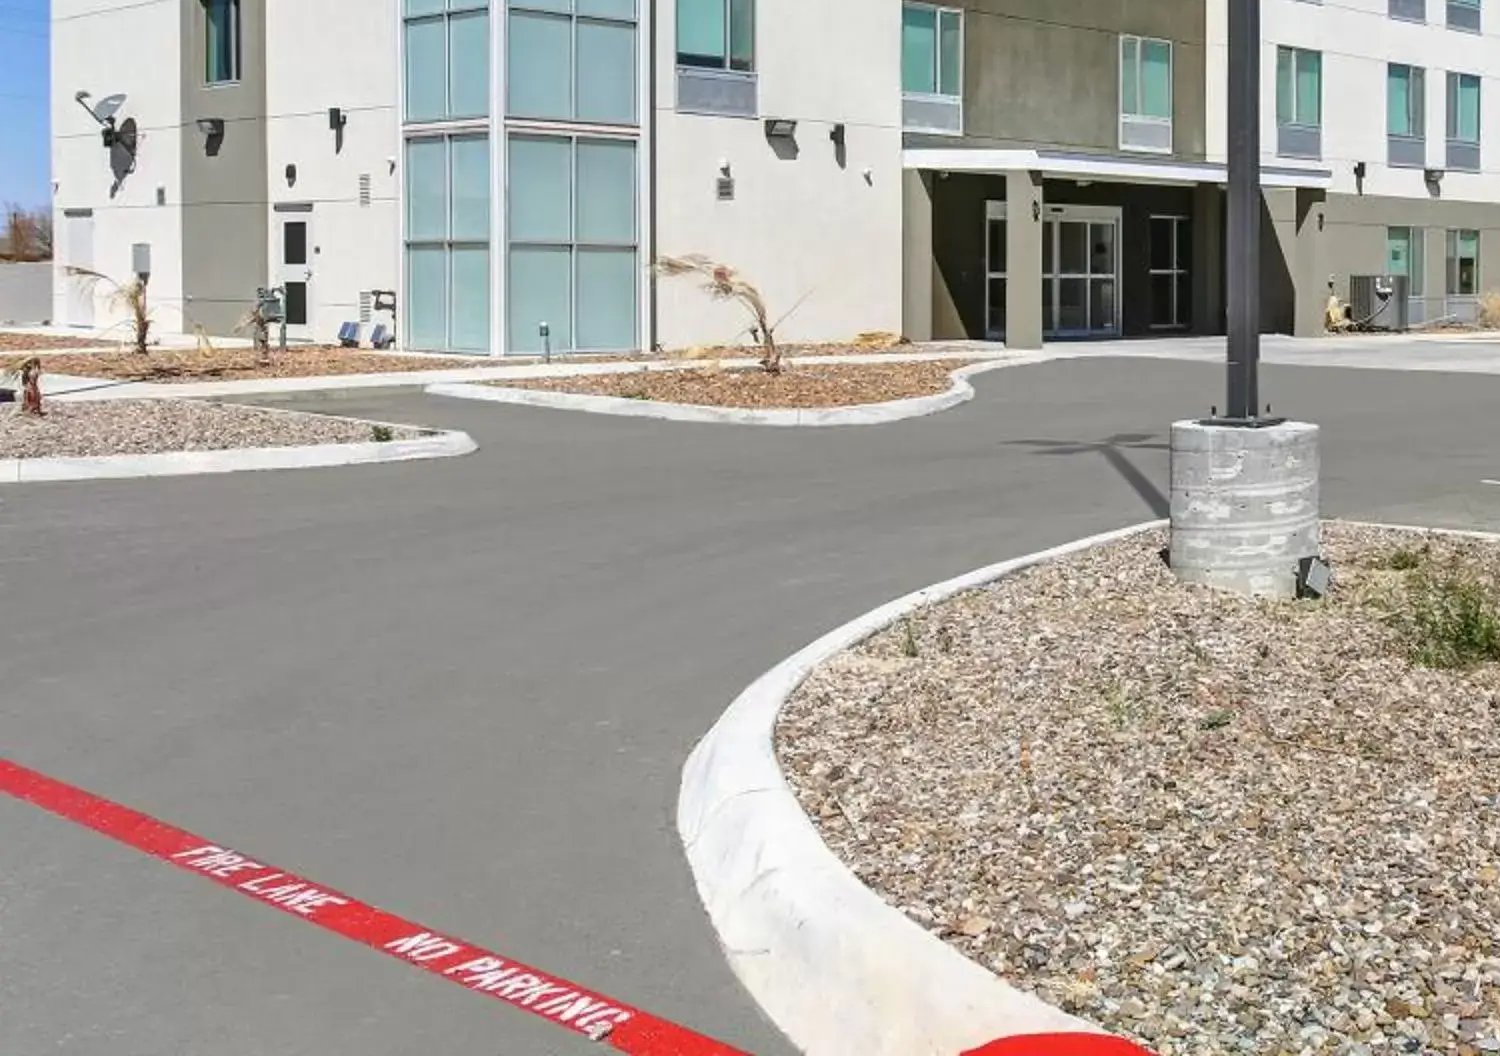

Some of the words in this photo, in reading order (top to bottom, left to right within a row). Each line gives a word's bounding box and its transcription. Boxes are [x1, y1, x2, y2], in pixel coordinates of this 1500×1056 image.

[170, 845, 267, 878] FIRE
[237, 873, 349, 914] LANE
[384, 932, 461, 962] NO
[444, 956, 633, 1042] PARKING
